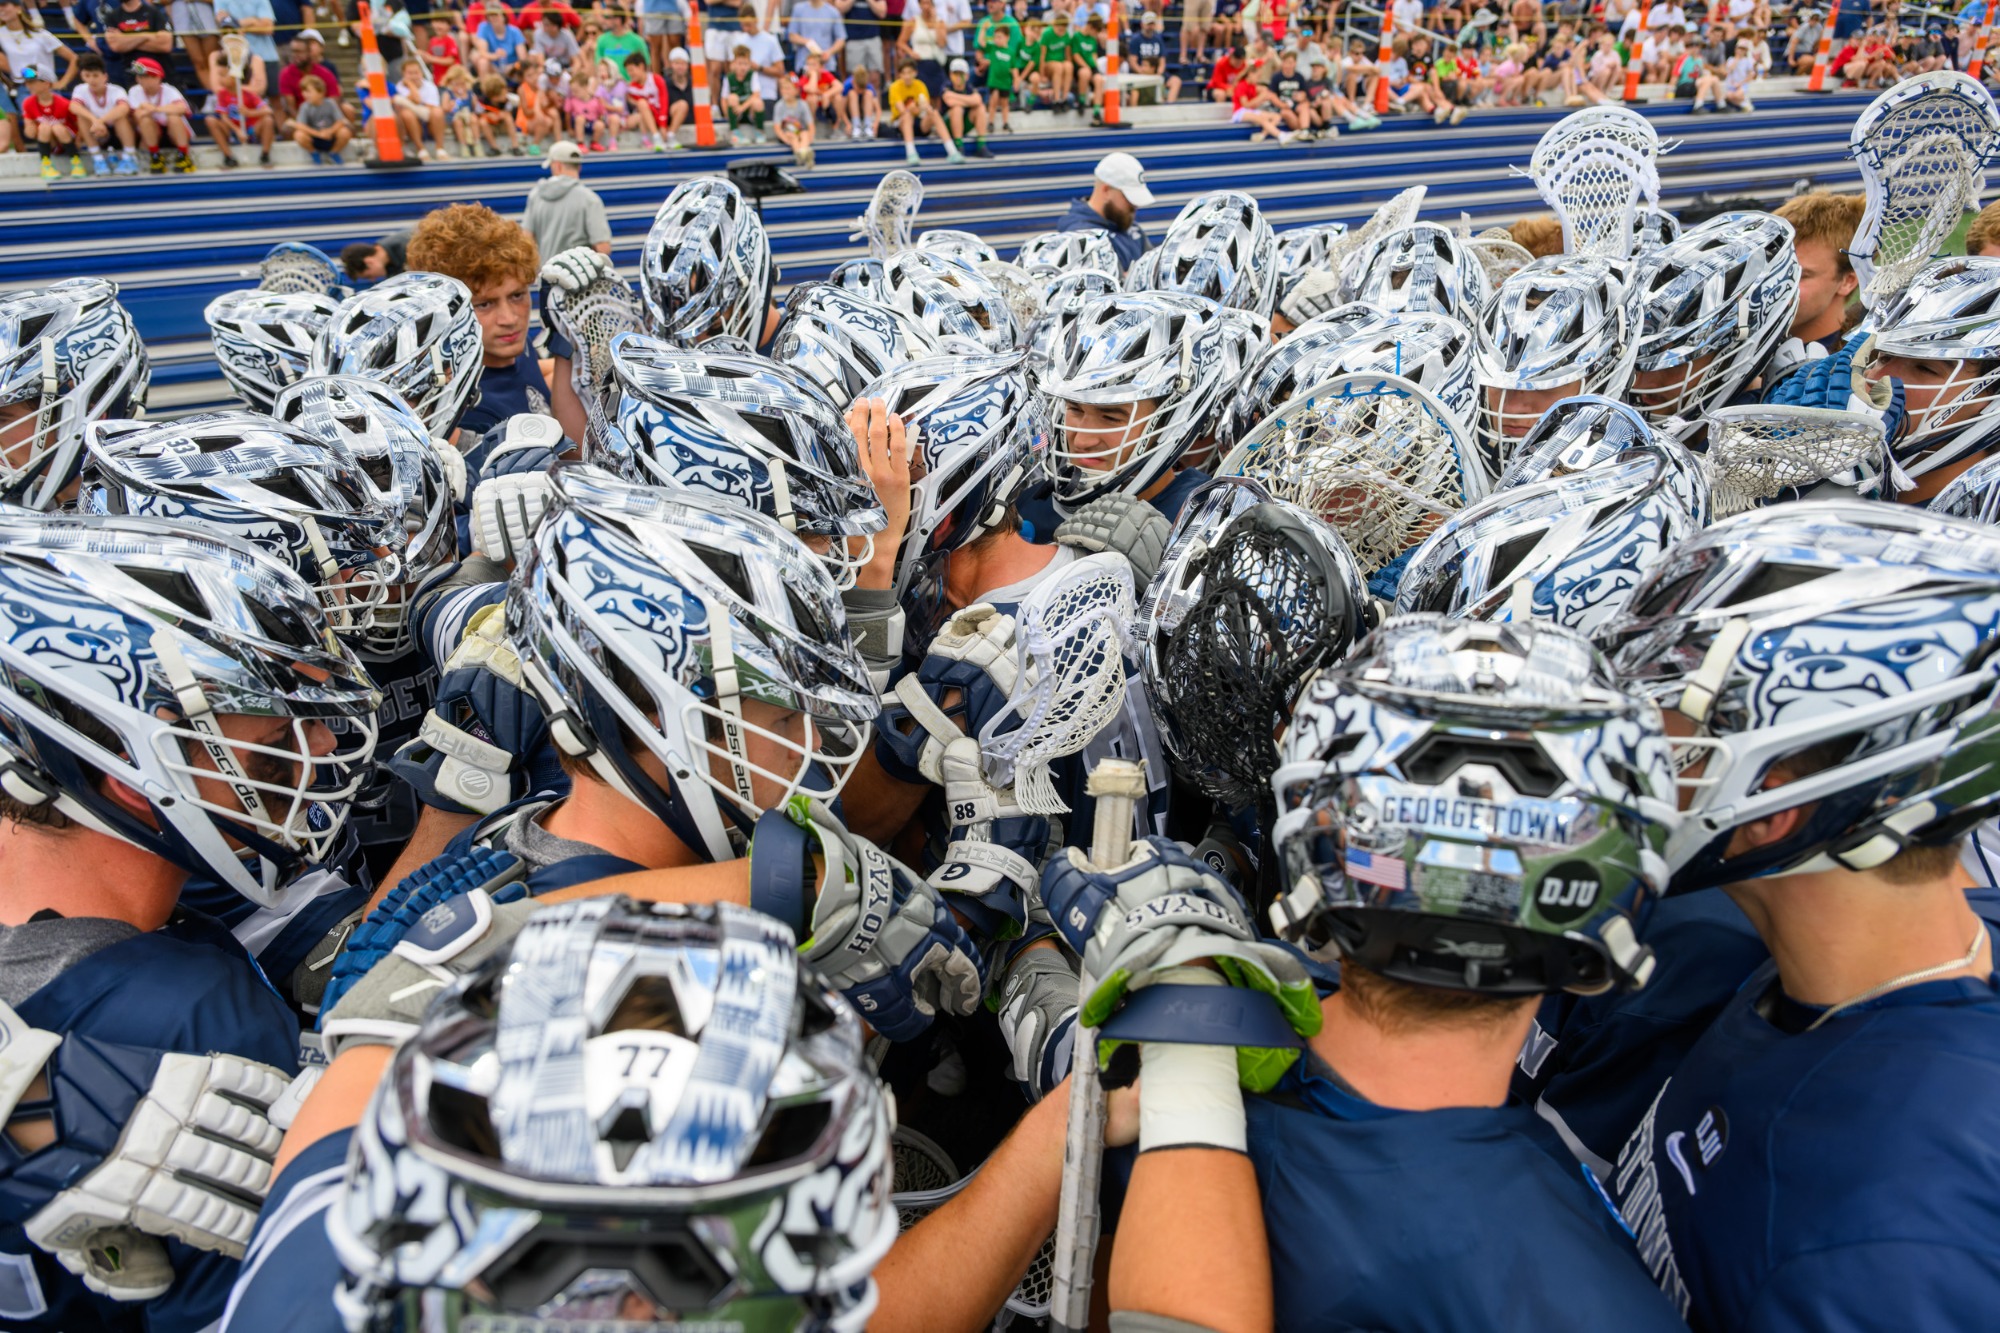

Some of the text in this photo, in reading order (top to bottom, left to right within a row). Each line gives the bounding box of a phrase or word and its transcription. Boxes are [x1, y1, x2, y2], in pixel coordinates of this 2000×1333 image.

[166, 437, 196, 455] 33
[954, 802, 977, 821] 88
[1382, 796, 1567, 844] GEORGETOWN
[847, 848, 892, 955] HOYAS
[1538, 877, 1599, 908] DJU
[1068, 906, 1088, 932] 5
[856, 993, 878, 1012] 5
[618, 1044, 672, 1078] 77
[1695, 1110, 1723, 1167] DJU
